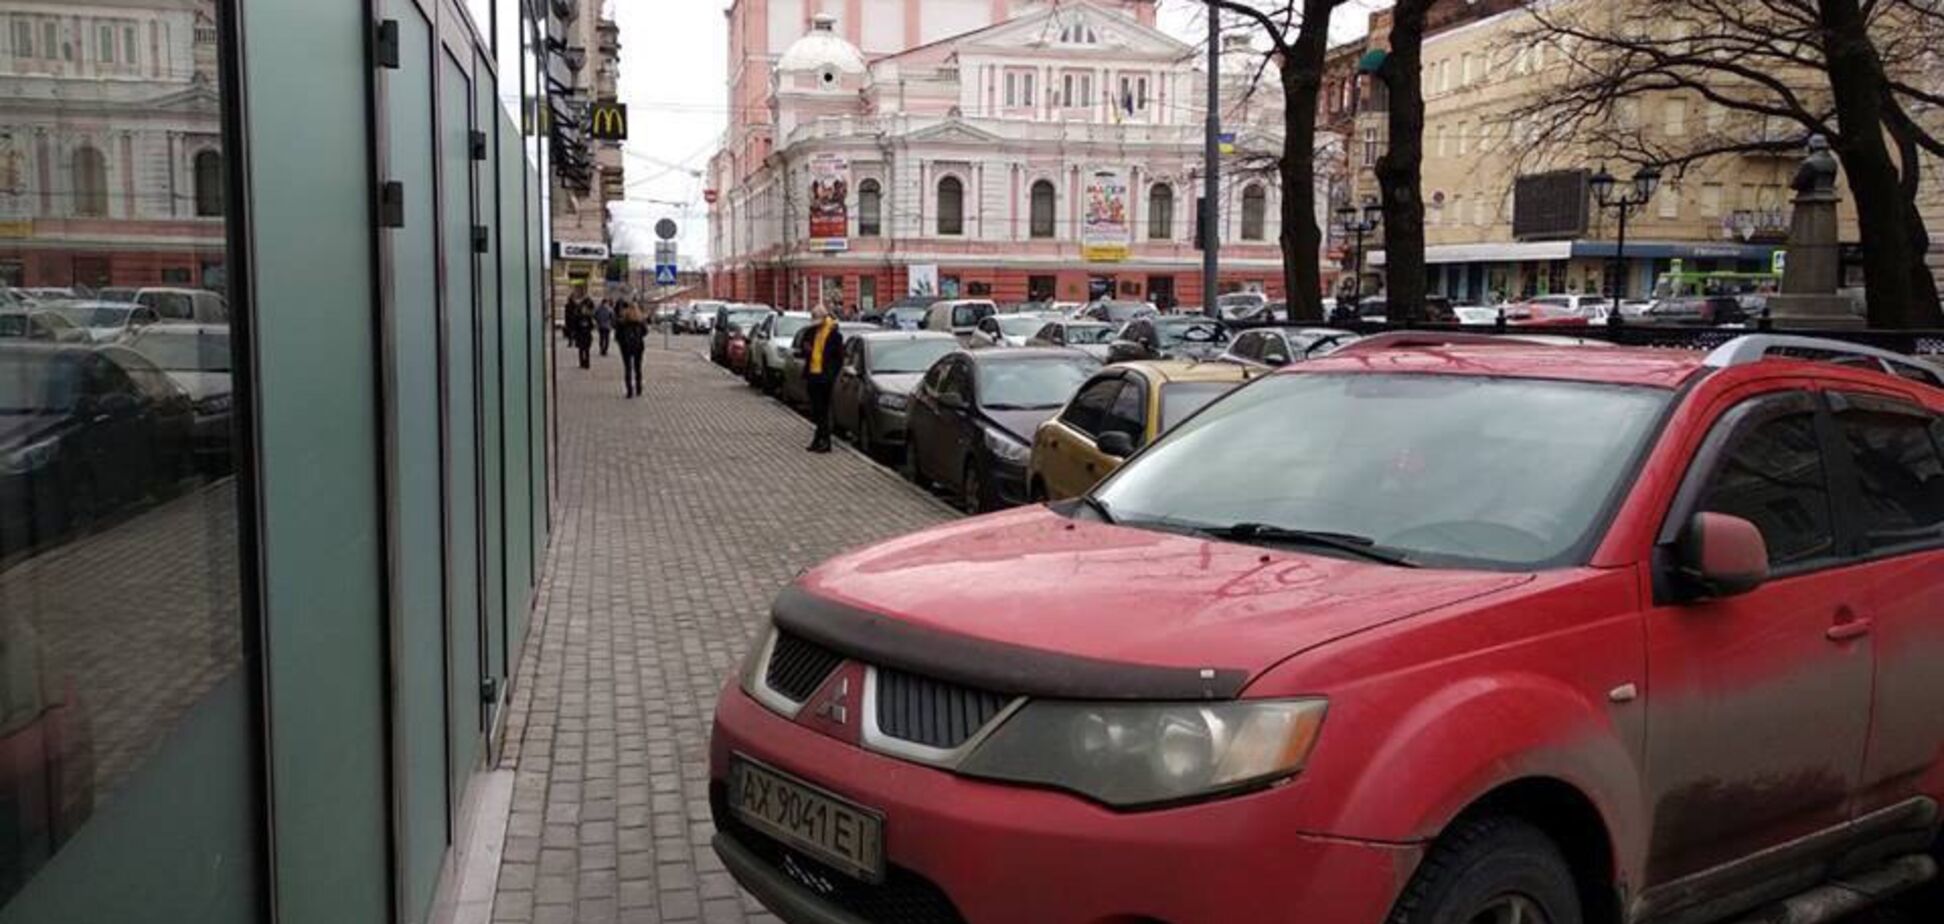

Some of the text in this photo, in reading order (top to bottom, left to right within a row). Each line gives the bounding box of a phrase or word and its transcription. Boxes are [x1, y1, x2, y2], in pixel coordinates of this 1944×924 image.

[743, 770, 865, 862] AX 9041 EI
